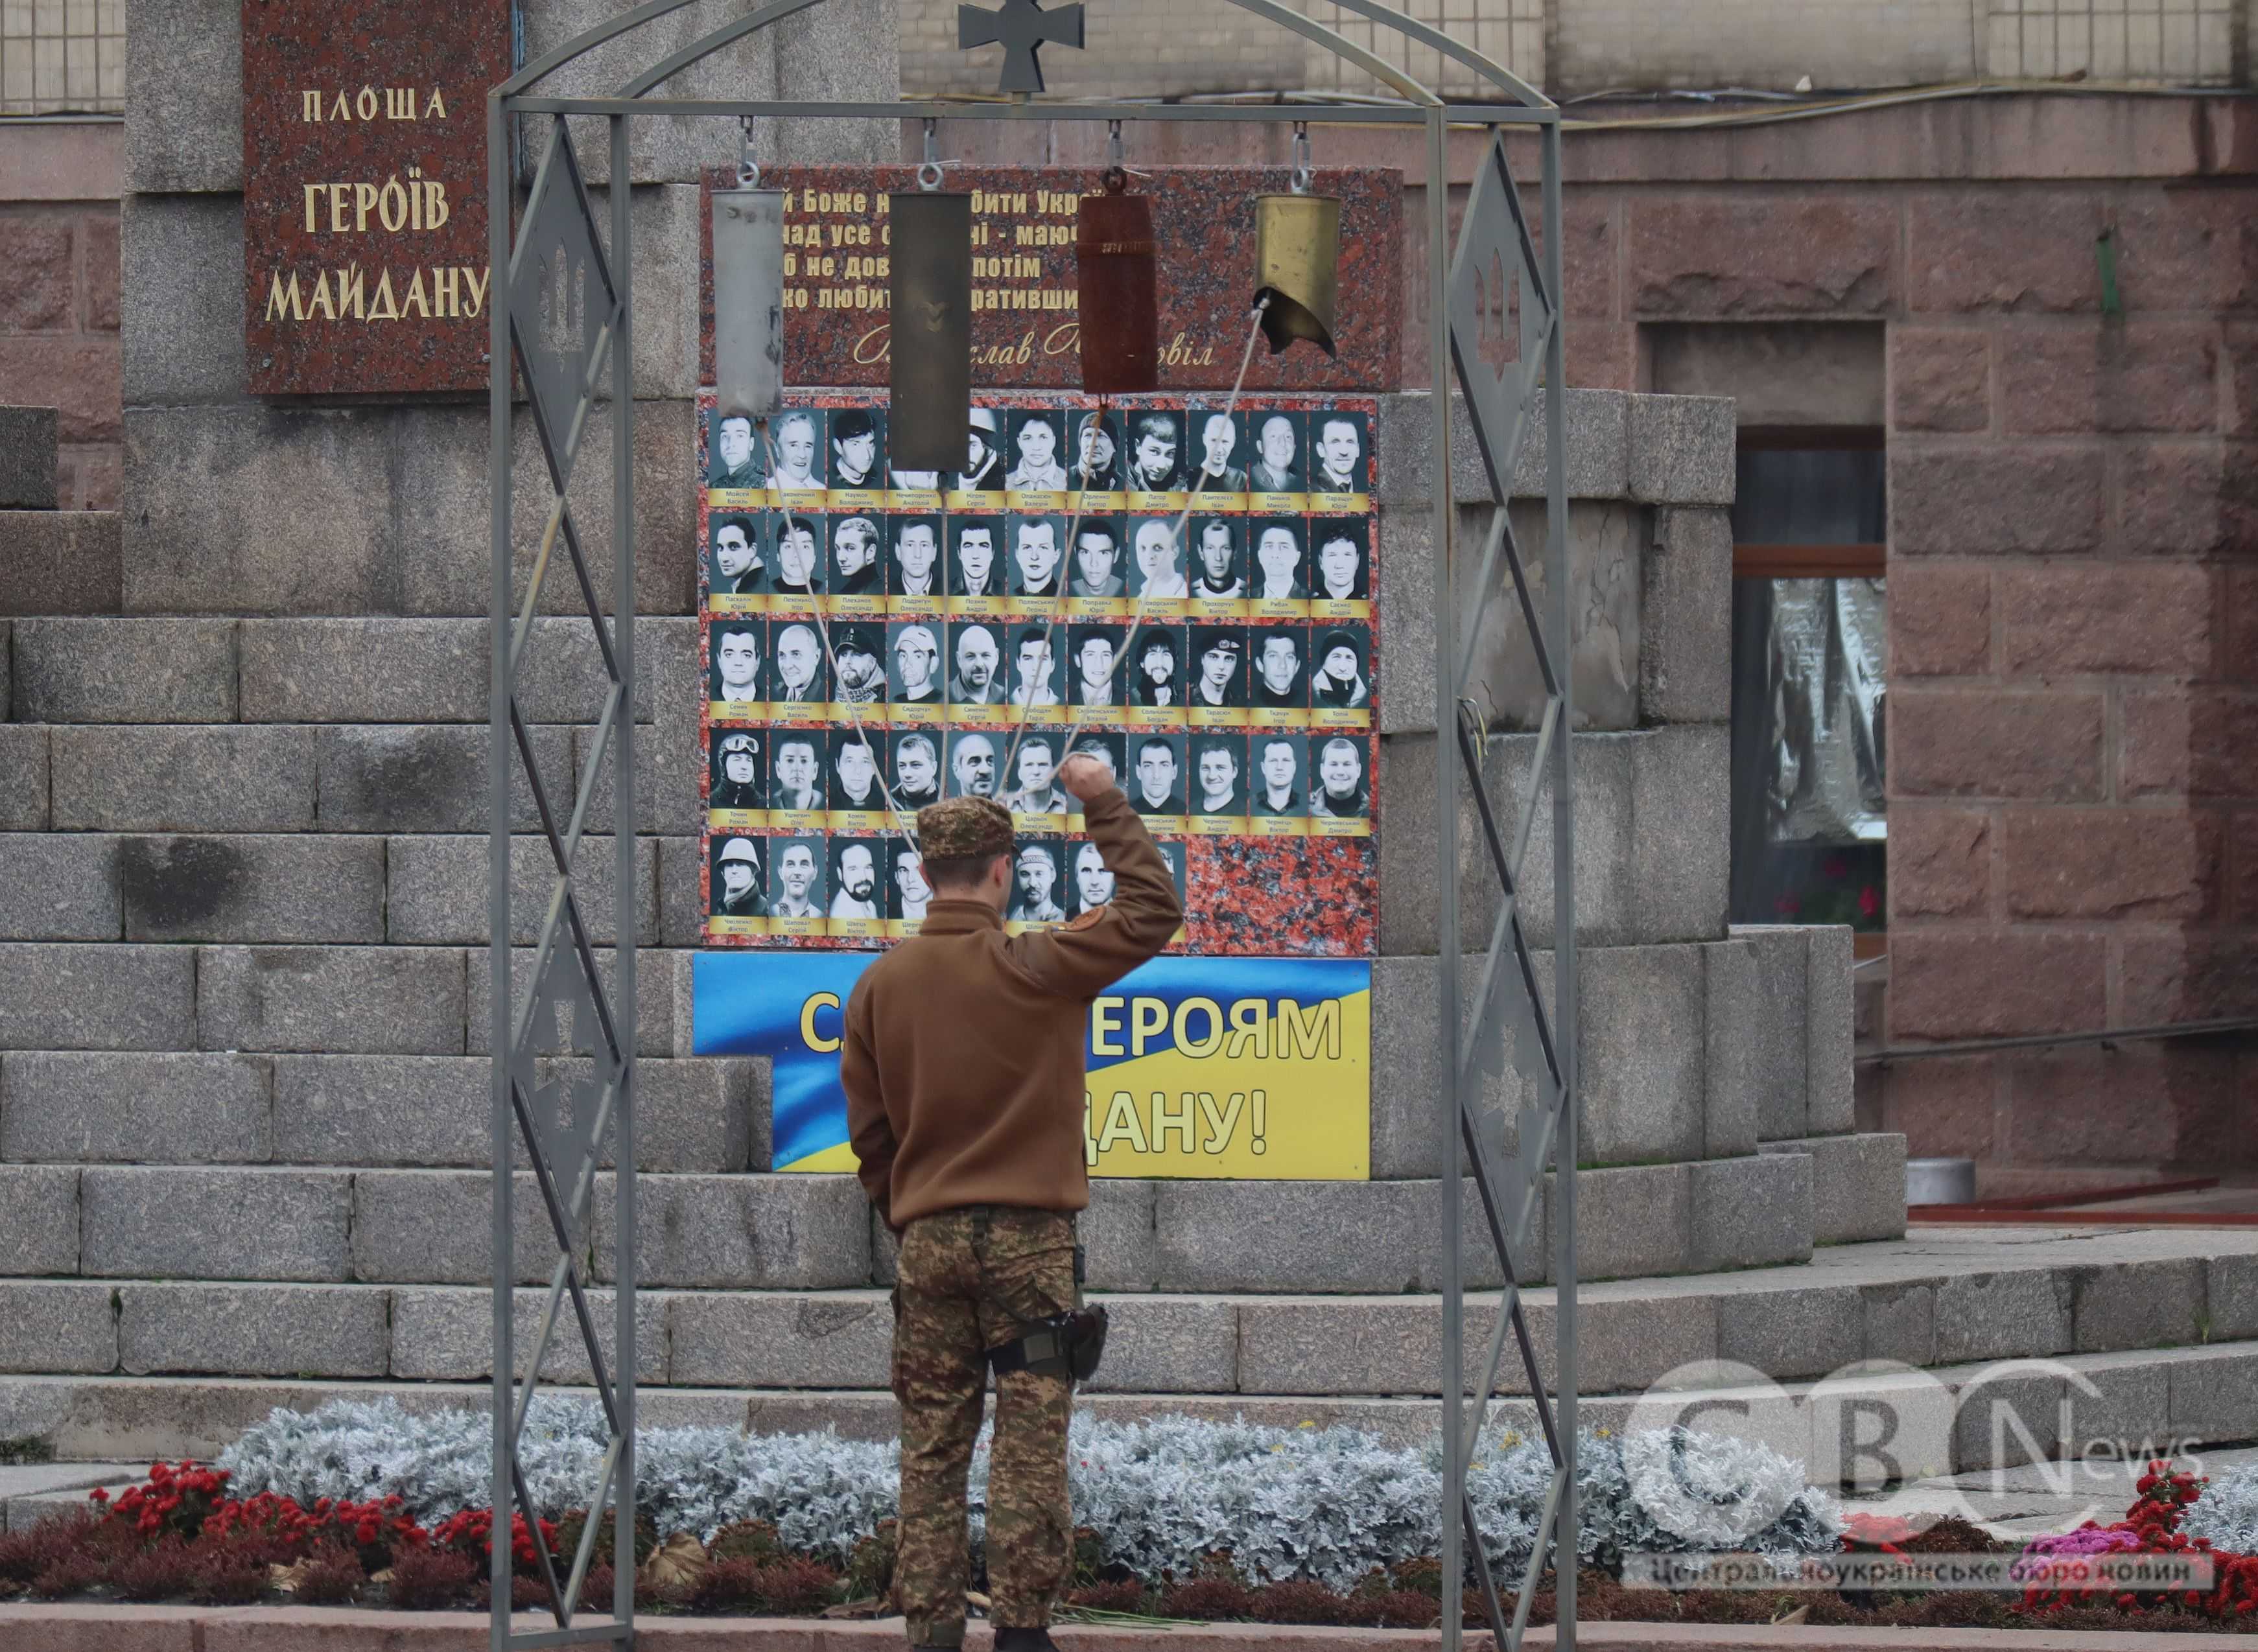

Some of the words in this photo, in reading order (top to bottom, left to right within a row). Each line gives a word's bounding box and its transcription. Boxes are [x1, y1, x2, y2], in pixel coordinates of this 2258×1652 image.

[301, 84, 447, 122] ПЛОЩА
[303, 167, 450, 233] ГЕРОЇВ
[803, 189, 867, 213] Боже
[831, 224, 871, 248] усе
[806, 256, 836, 277] не
[972, 253, 1041, 278] потім
[265, 261, 491, 323] МАЙДАНУ
[1091, 996, 1341, 1060] ЕРОЯМ
